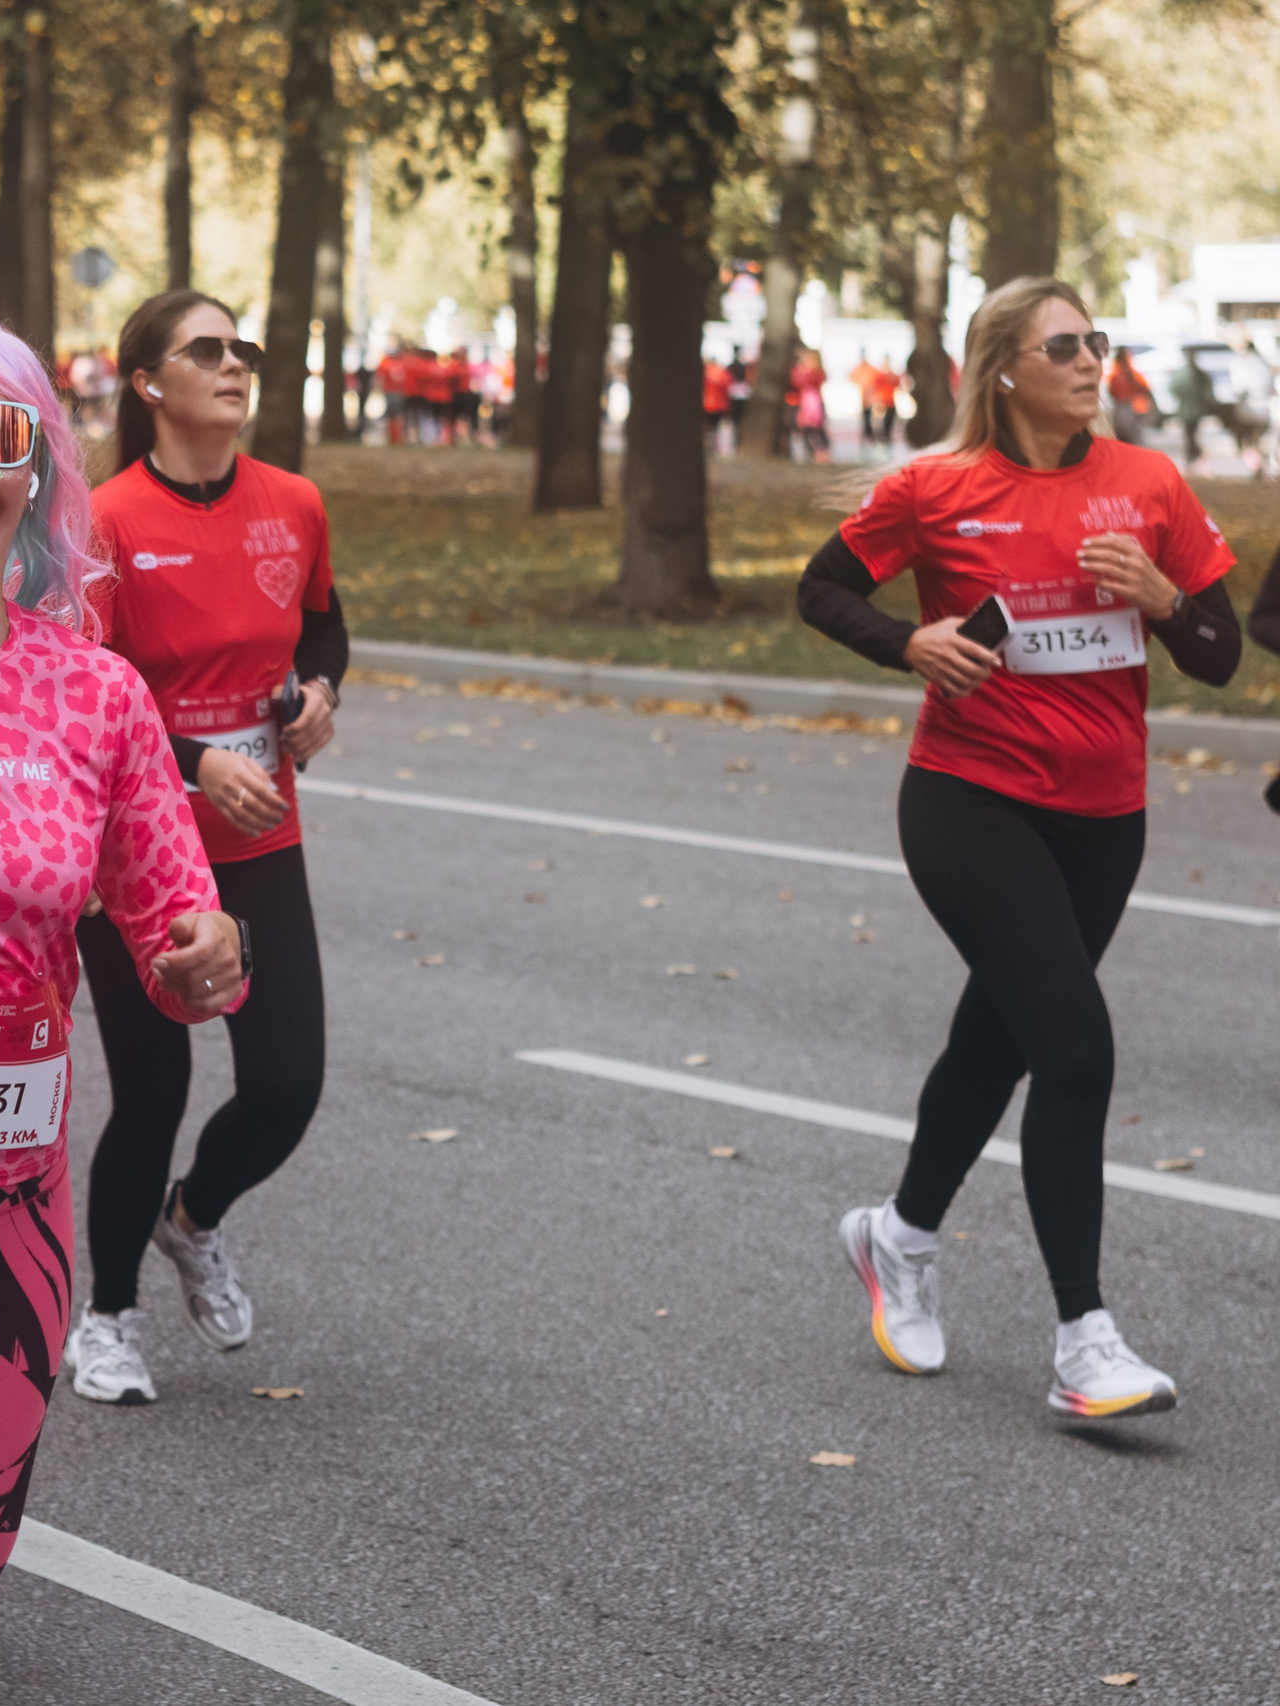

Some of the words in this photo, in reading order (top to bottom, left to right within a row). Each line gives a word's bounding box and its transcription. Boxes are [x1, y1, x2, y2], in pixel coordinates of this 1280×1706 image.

[1021, 625, 1109, 654] 31134
[23, 762, 51, 781] ME
[48, 1071, 62, 1126] МОСКВА
